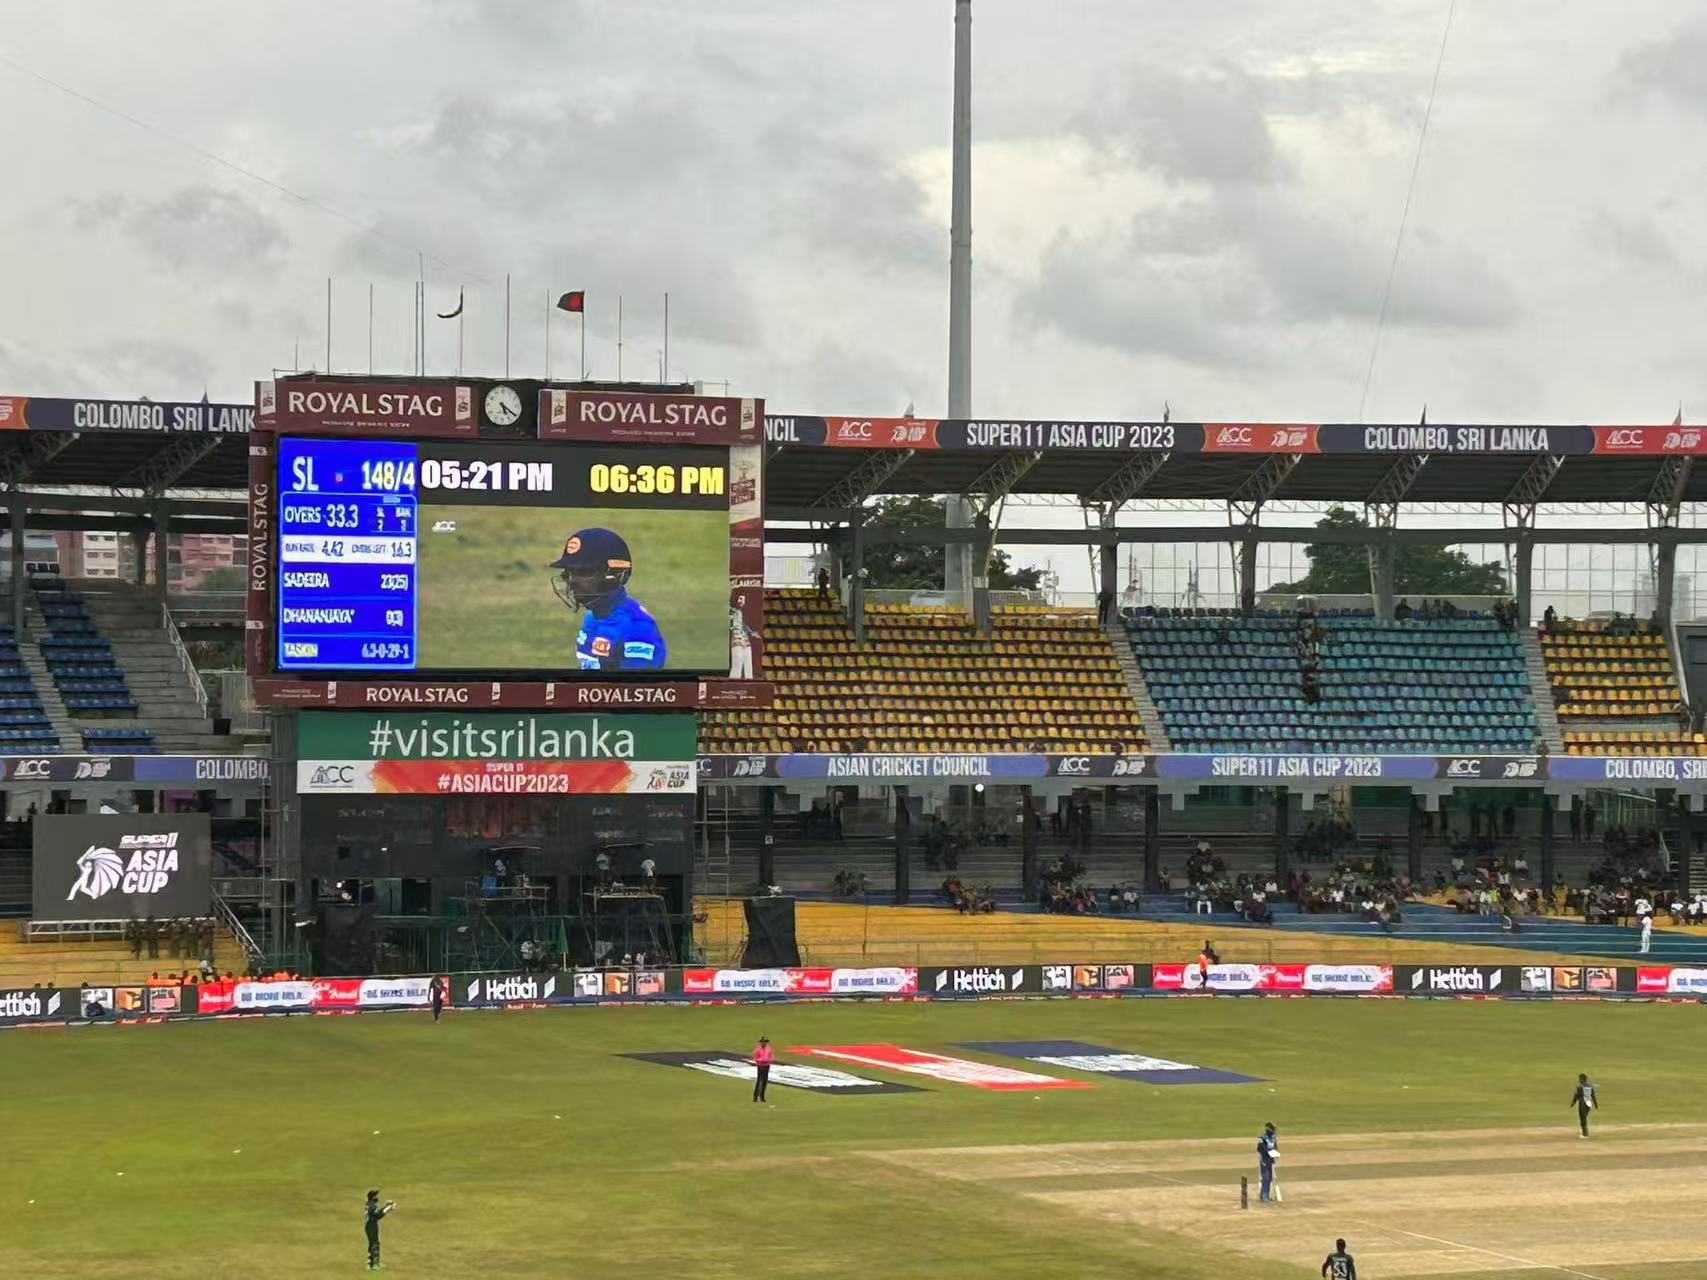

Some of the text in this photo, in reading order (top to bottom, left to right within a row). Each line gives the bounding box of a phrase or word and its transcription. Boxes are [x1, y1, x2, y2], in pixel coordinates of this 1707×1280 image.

[74, 402, 169, 434] COLOMBO,
[173, 406, 204, 431] SRI
[837, 421, 872, 438] ACC
[1048, 424, 1087, 448] ASIA
[1091, 424, 1125, 448] CUP
[1129, 425, 1175, 448] 2023
[1216, 427, 1252, 443] ACC
[1364, 427, 1549, 451] COLOMBO, SRI LANKA
[1606, 429, 1643, 445] ACC
[293, 456, 416, 492] SL 148/4
[421, 459, 553, 492] 05:21 PM
[590, 463, 675, 495] 06:36
[681, 467, 724, 496] PM
[284, 505, 322, 524] OVERS
[326, 503, 359, 529] 33.3
[369, 718, 635, 758] #visitsrilanka
[14, 759, 51, 776] ACC
[310, 765, 355, 785] ACC
[827, 757, 991, 777] ASIAN CRICKET COUNCIL
[1057, 757, 1091, 773] ACC
[1276, 757, 1310, 777] ASIA
[1313, 757, 1342, 777] CUP
[1344, 757, 1383, 777] 2023
[1447, 759, 1480, 775] ACC
[1605, 758, 1680, 780] COLOMBO,
[437, 773, 569, 793] #ASIACUP2023
[126, 849, 179, 871] ASIA
[122, 871, 169, 894] CUP
[486, 975, 537, 1001] Hettich
[953, 967, 1006, 992] Hettich
[1430, 967, 1484, 990] Hettich
